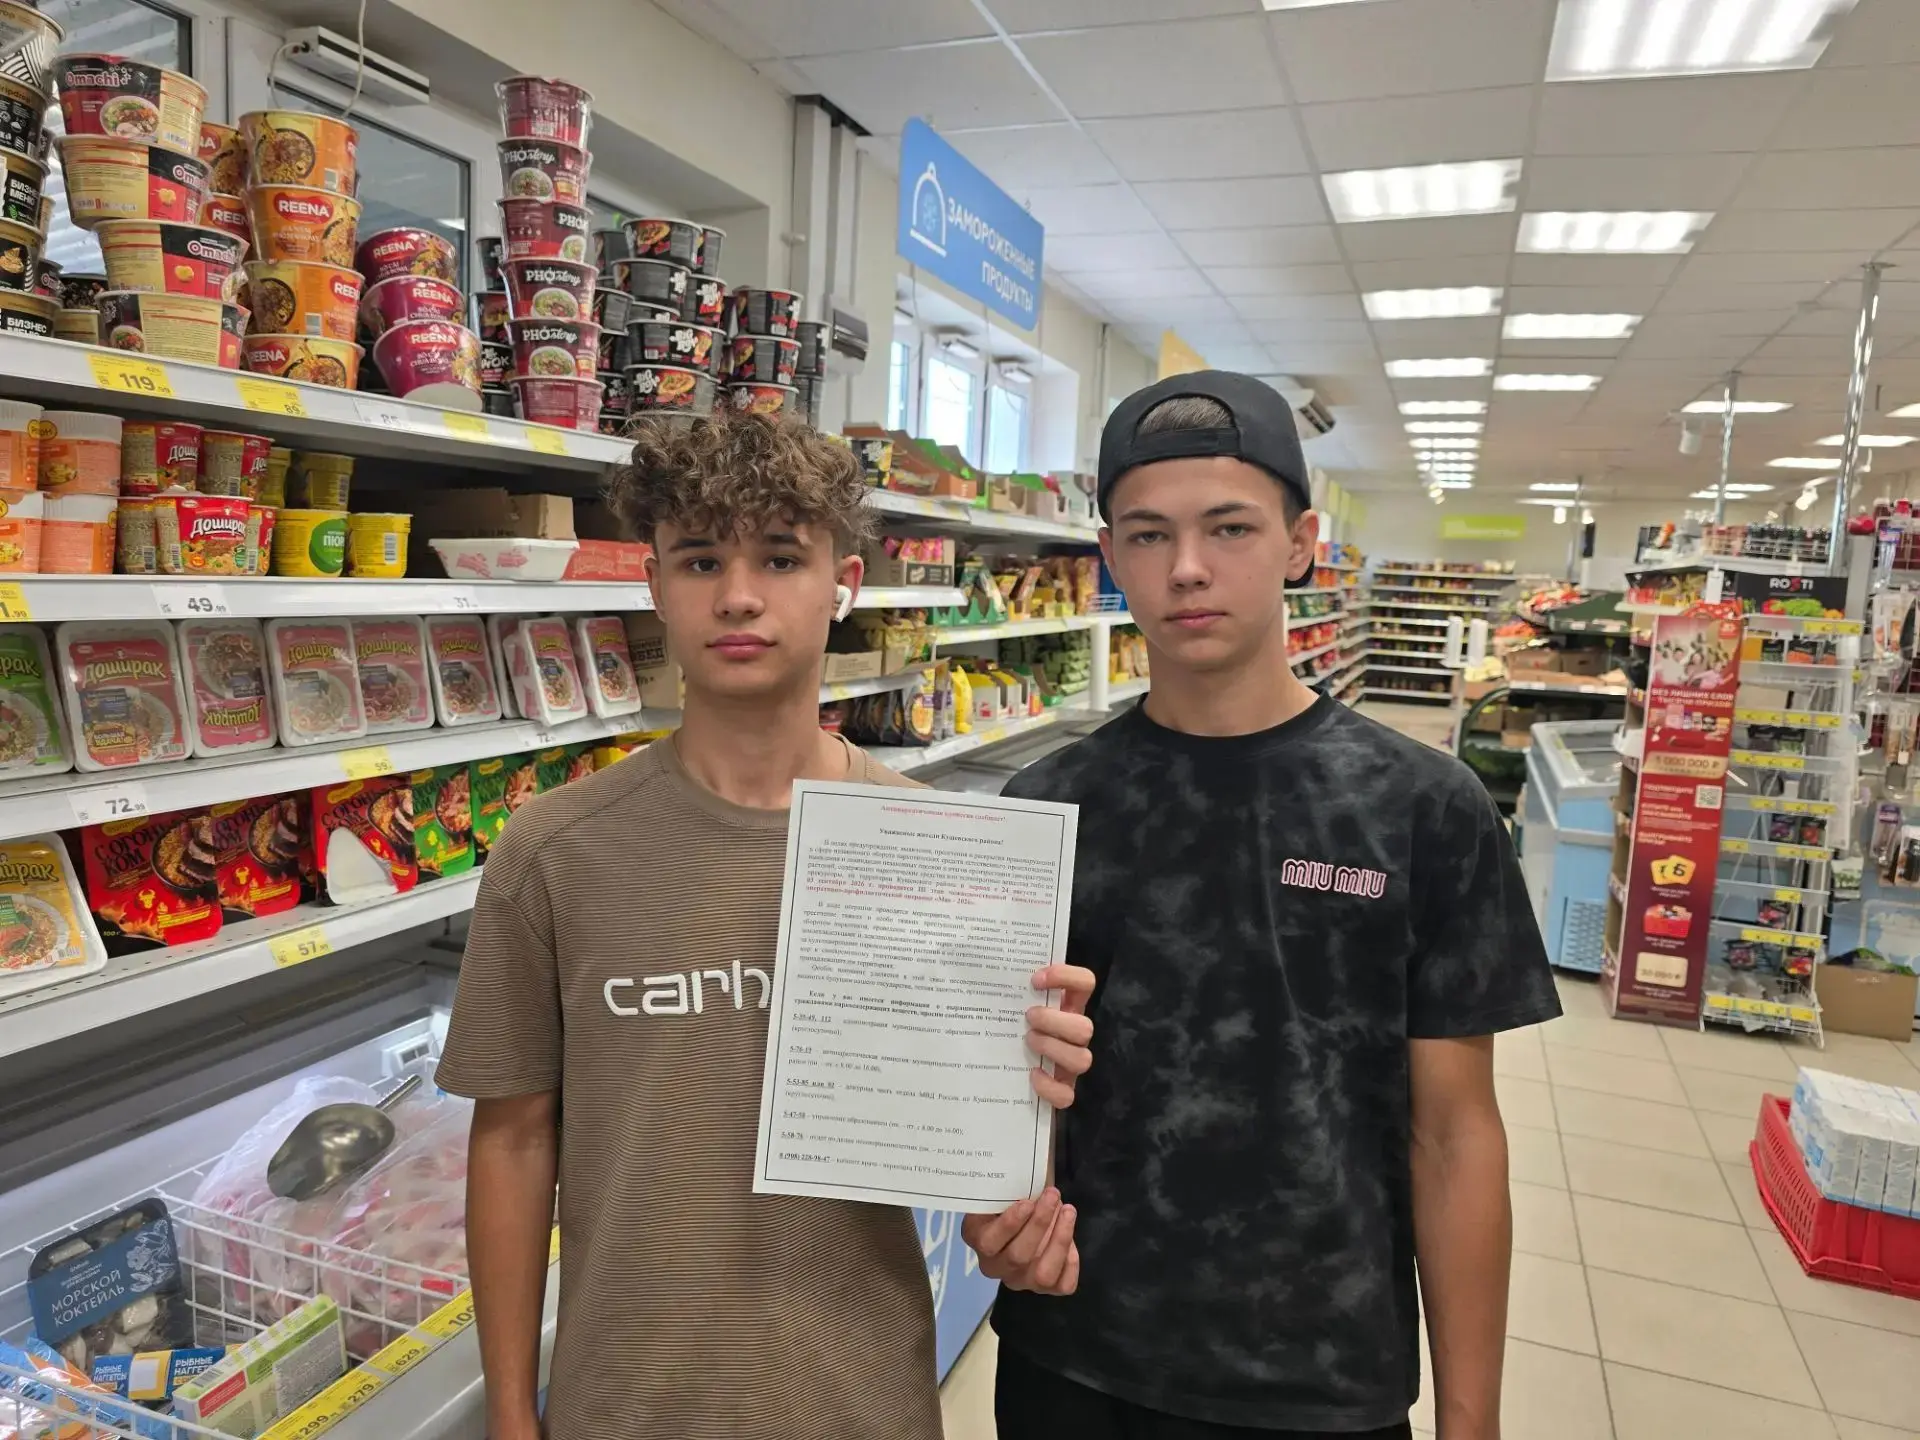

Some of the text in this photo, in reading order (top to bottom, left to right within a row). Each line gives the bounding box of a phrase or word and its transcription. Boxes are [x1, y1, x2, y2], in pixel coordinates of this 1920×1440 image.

[65, 71, 120, 87] Omachi
[279, 199, 330, 218] REENA
[948, 197, 1035, 281] ЗАМОРОЖЕННЫЕ
[373, 241, 415, 258] REENA
[412, 287, 454, 305] REENA
[981, 261, 1033, 312] ПРОДУКТЫ
[7, 317, 47, 334] БИЗНЕС
[411, 332, 457, 345] REENA
[84, 659, 167, 688] Доширак
[1281, 858, 1387, 899] MIU MIU
[51, 1269, 122, 1314] МОРСКОЙ
[54, 1285, 126, 1328] КОКТЕЙЛЬ
[94, 1364, 123, 1375] РЫБНЫЕ
[175, 1356, 214, 1368] РЫБНЫЕ
[347, 1382, 375, 1403] 279
[299, 1414, 330, 1436] 299
